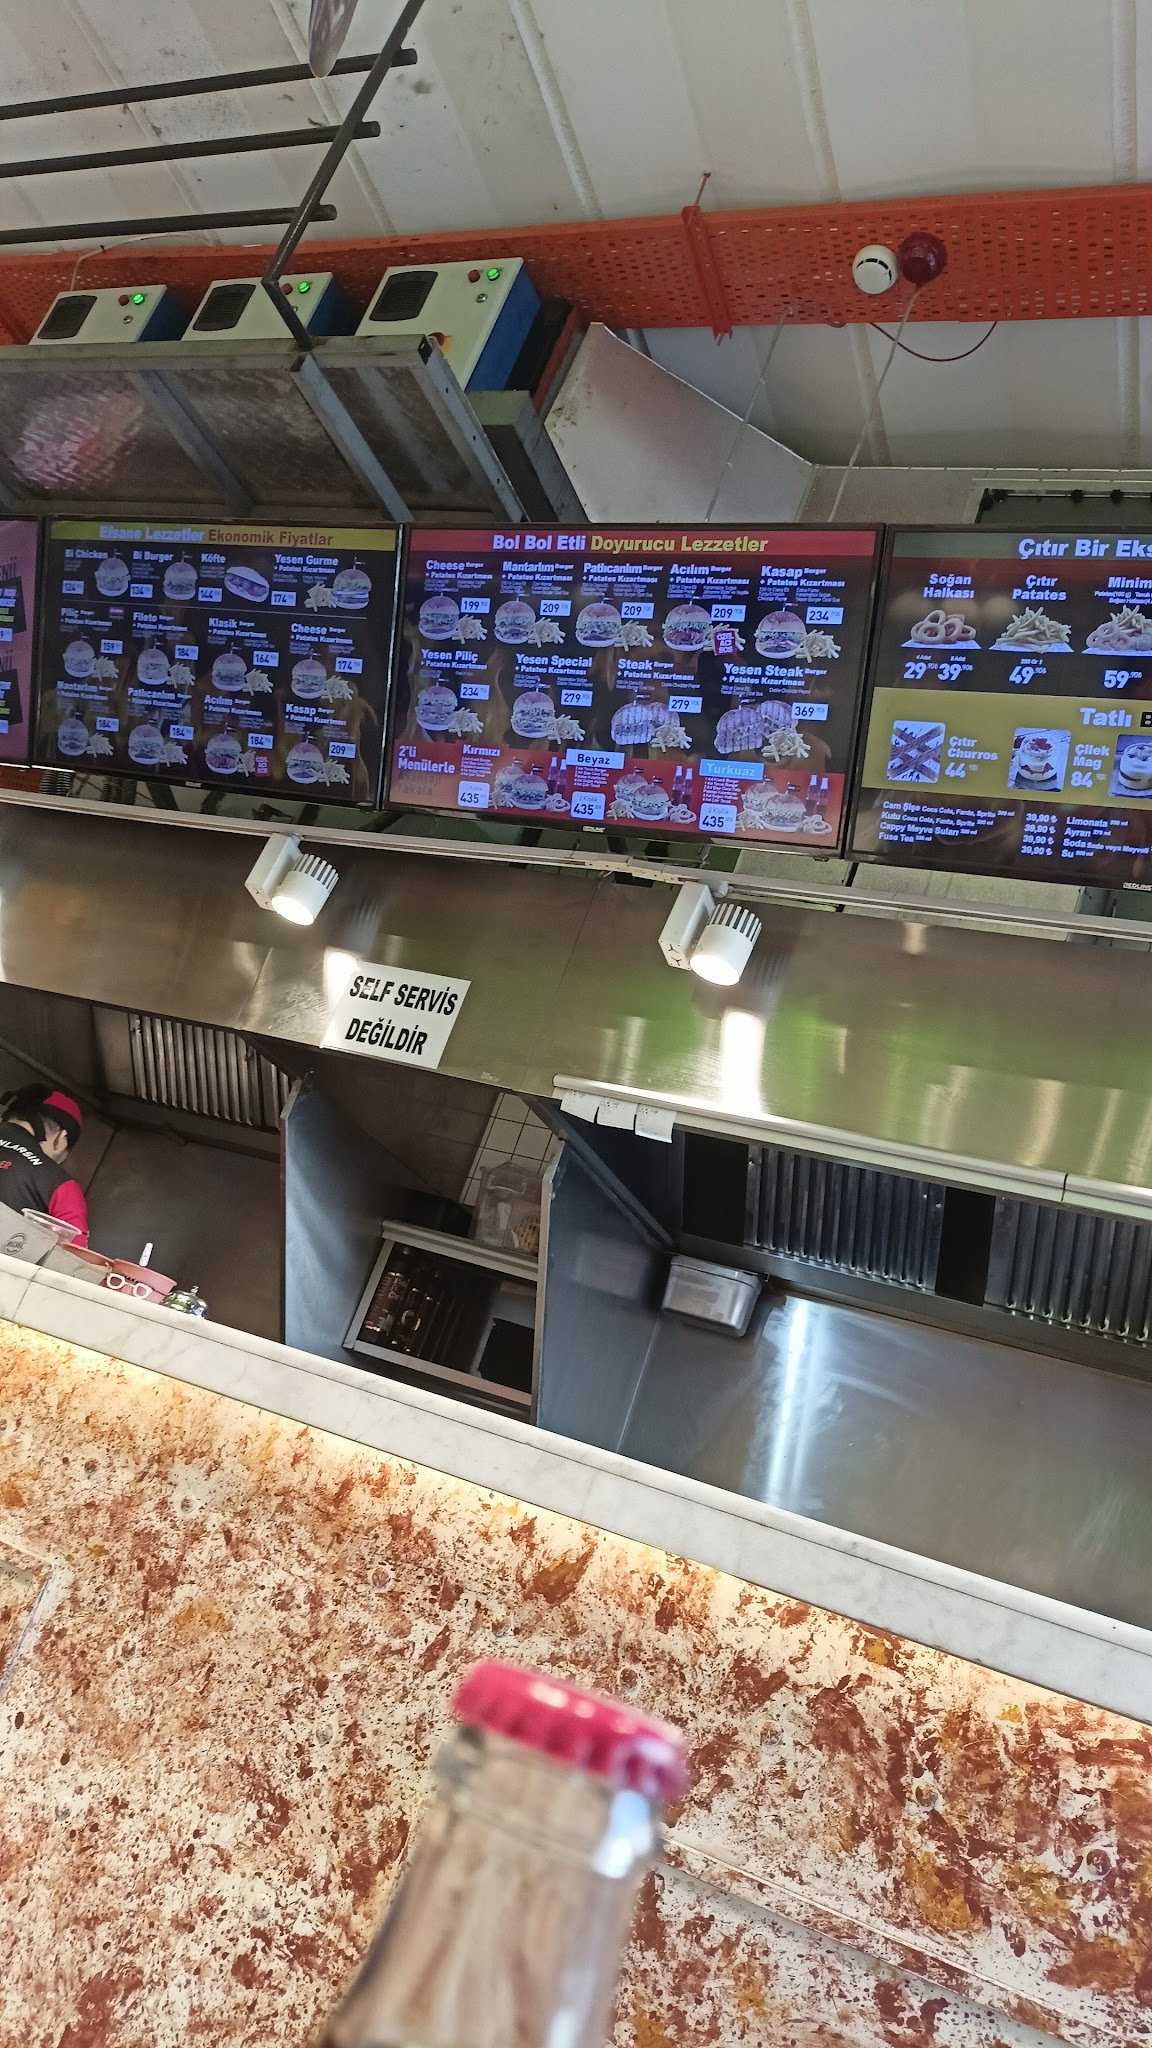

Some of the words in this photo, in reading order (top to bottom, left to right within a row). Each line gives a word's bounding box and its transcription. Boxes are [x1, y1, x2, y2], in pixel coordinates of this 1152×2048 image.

[208, 529, 274, 543] Ekonomik
[279, 532, 333, 547] Fiyatlar
[493, 534, 520, 549] Bol
[524, 535, 552, 550] Bol
[556, 536, 586, 550] Etli
[591, 536, 675, 554] Doyurucu
[681, 536, 768, 552] Lezzetler
[65, 549, 74, 558] Bi
[1018, 538, 1069, 560] Çıtır
[1075, 540, 1110, 557] Bir
[133, 551, 142, 560] Bi
[144, 552, 174, 562] Burger
[201, 553, 226, 563] Köfte
[274, 554, 303, 564] Yesen
[306, 555, 339, 566] Gurme
[426, 560, 464, 570] Cheese
[503, 561, 554, 572] Mantarlım
[584, 562, 642, 574] Patlıcanlım
[670, 564, 710, 574] Acılım
[761, 566, 803, 580] Kasap
[929, 574, 972, 587] Soğan
[1026, 575, 1058, 588] Çıtır
[923, 587, 975, 599] Halkası
[1012, 588, 1067, 601] Patates
[463, 601, 480, 610] 199
[542, 604, 560, 614] 209
[623, 606, 642, 616] 209
[713, 608, 733, 618] 209
[809, 610, 830, 621] 234
[209, 618, 237, 628] Klasik
[291, 623, 326, 634] Cheese
[255, 654, 270, 664] 164
[422, 649, 452, 660] Yesen
[455, 651, 478, 664] Piliç
[516, 654, 548, 665] Yesen
[551, 655, 592, 668] Special
[338, 660, 352, 670] 174
[618, 658, 653, 670] Steak
[724, 663, 762, 676] Yesen
[765, 664, 804, 678] Steak
[462, 686, 479, 696] 234
[564, 692, 581, 703] 279
[286, 704, 316, 716] Kasap
[671, 700, 690, 710] 279
[794, 706, 814, 717] 369
[1080, 708, 1132, 728] Tatlı
[250, 736, 264, 746] 184
[950, 736, 978, 748] Çıtır
[331, 744, 346, 755] 209
[462, 744, 500, 757] Kırmızı
[948, 748, 998, 761] Churros
[1075, 744, 1110, 756] Çilek
[577, 753, 610, 766] Beyaz
[1073, 756, 1102, 770] Mag
[398, 758, 456, 774] Menülerle
[706, 763, 756, 778] Turkuaz
[945, 763, 966, 778] 44
[1071, 771, 1093, 788] 84
[460, 792, 480, 804] 435
[573, 803, 594, 816] 435
[883, 801, 901, 810] Cam
[702, 815, 724, 828] 435
[1026, 812, 1050, 823] 39,90
[1066, 816, 1108, 828] Limonata
[880, 822, 906, 832] Cappy
[1024, 824, 1048, 834] 39,90
[1064, 828, 1091, 838] Ayran
[900, 834, 914, 842] Tea
[1022, 834, 1046, 845] 39,90
[1063, 838, 1086, 848] Soda
[1020, 845, 1044, 856] 39,90
[1062, 849, 1074, 858] Su
[350, 975, 396, 1002] SELF
[394, 984, 458, 1016] SERVİS
[345, 1017, 428, 1056] DEĞİLDİR
